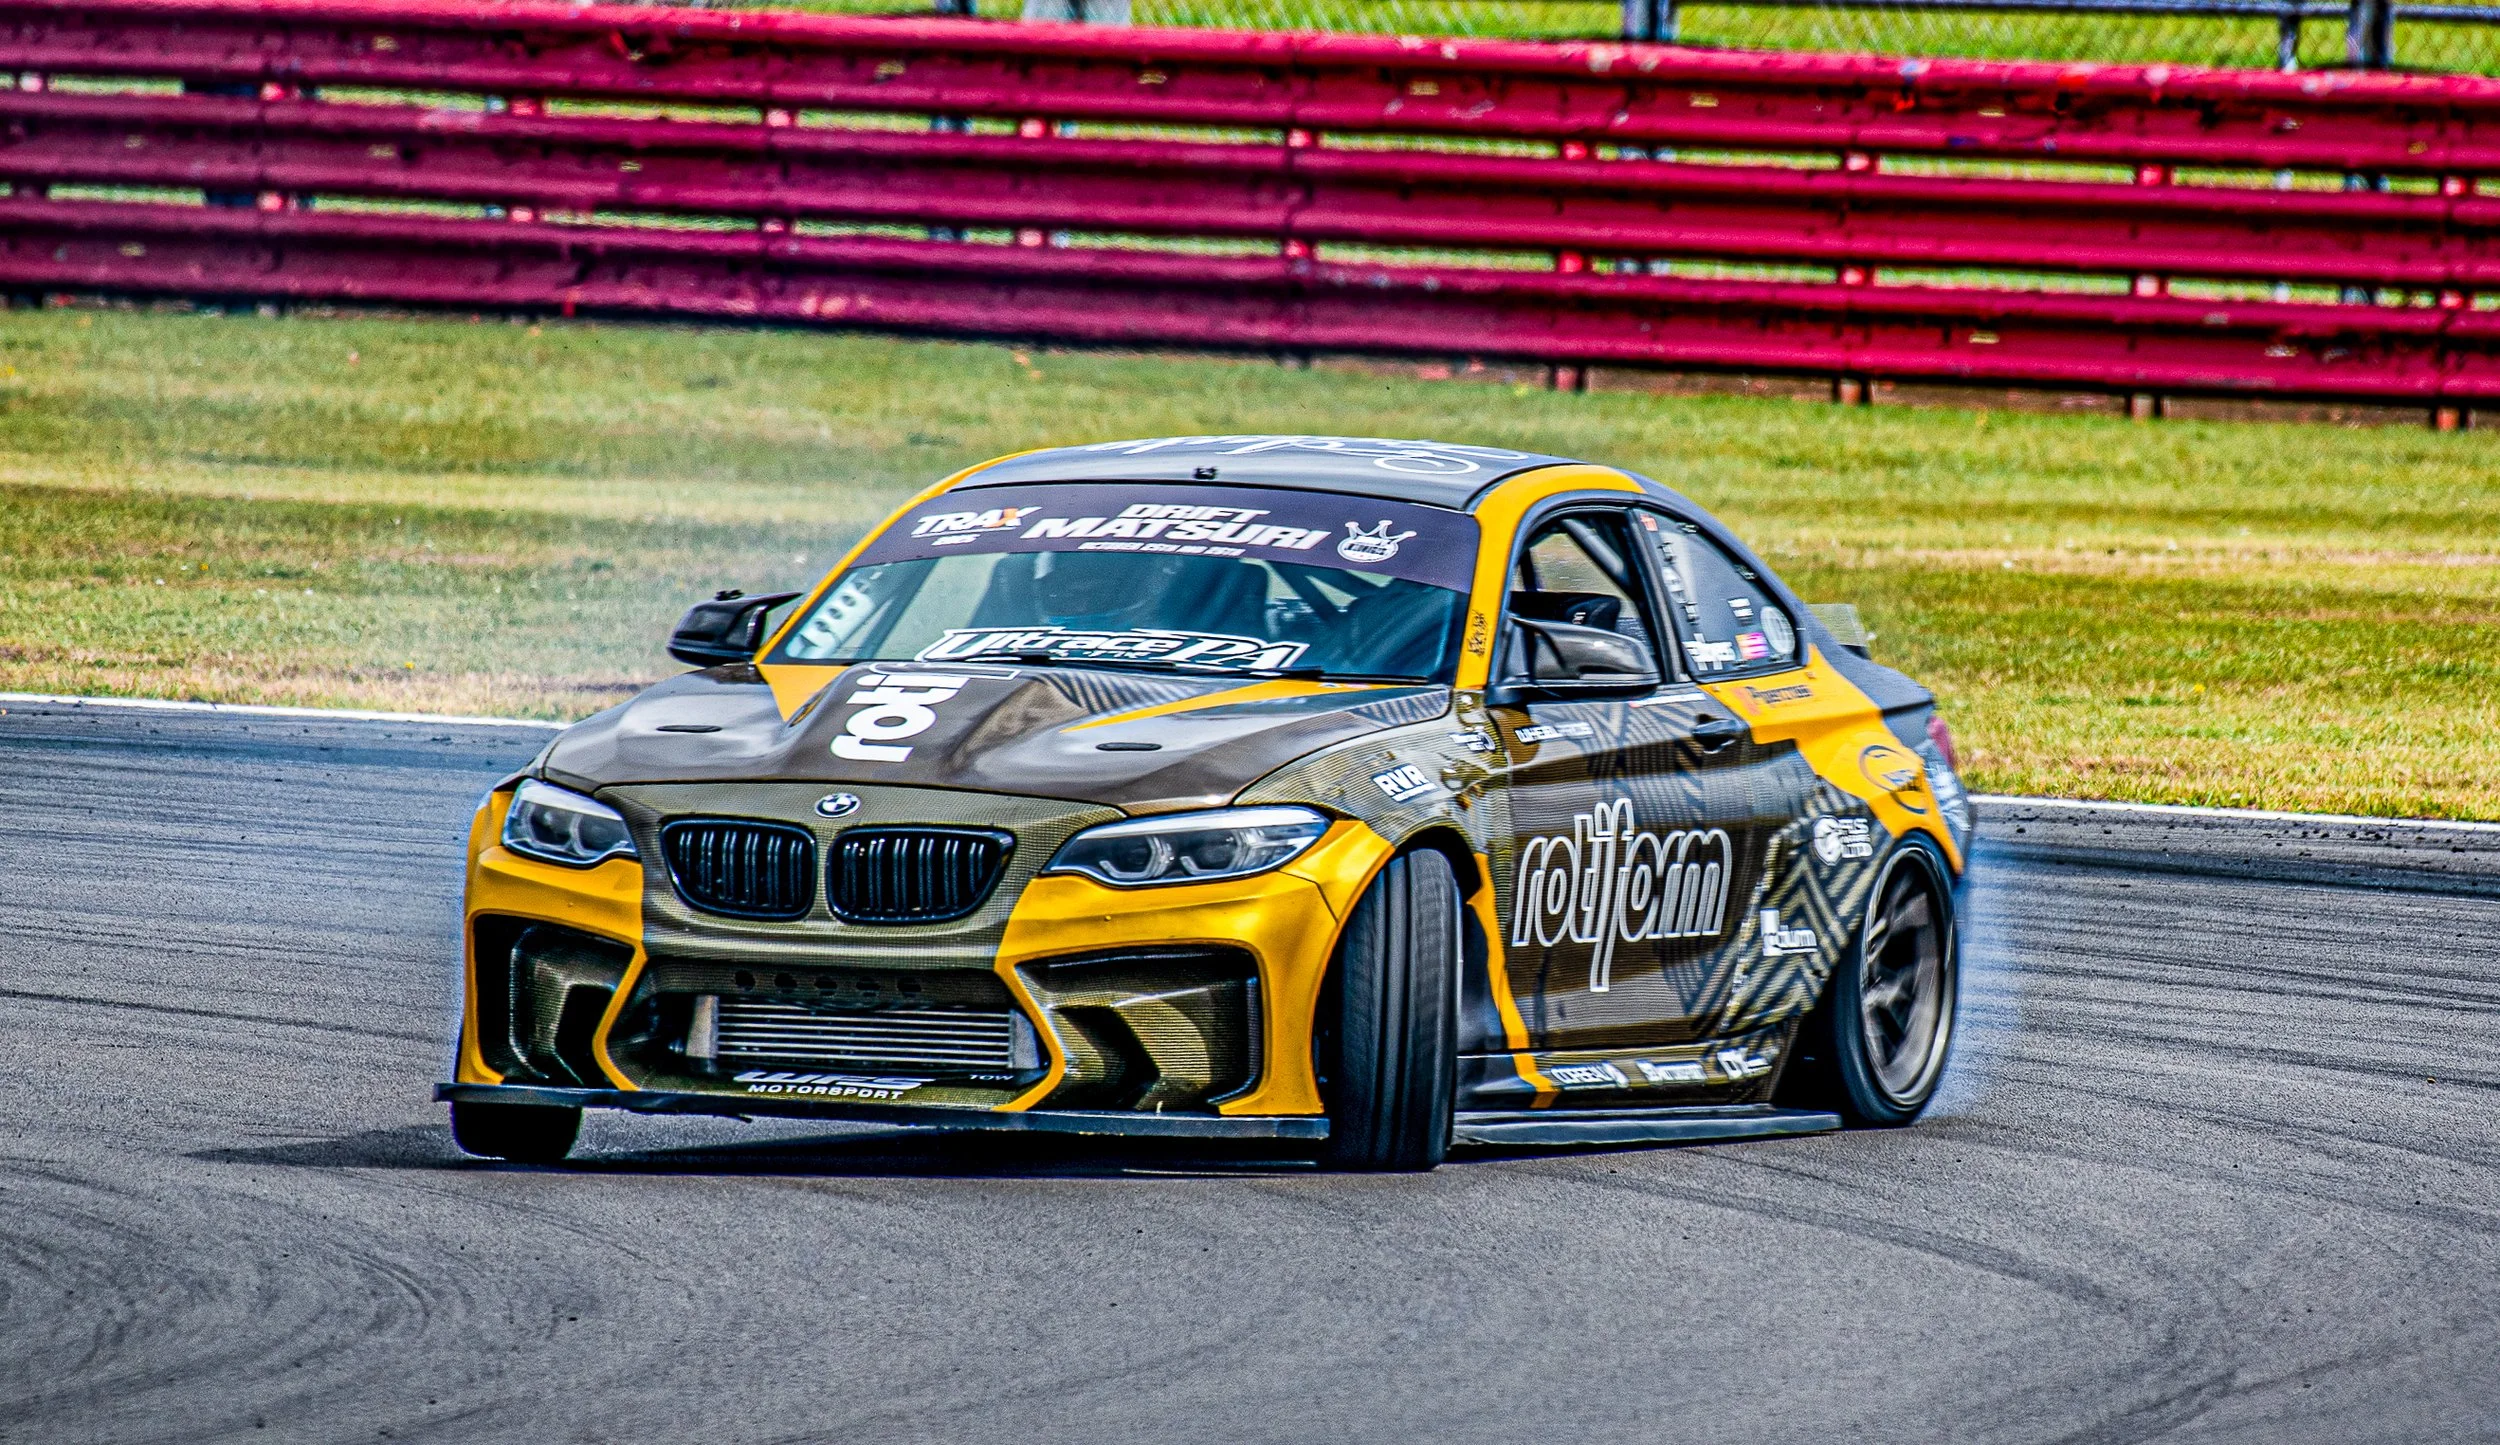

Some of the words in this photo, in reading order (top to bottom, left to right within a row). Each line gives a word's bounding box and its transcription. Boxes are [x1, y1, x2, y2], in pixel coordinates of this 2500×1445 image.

[911, 506, 1043, 536] TRAX
[1117, 503, 1271, 523] DRIFT
[1020, 517, 1332, 550] MATSURI
[1373, 764, 1429, 797] RVR
[1511, 797, 1733, 993] rotiform
[748, 1083, 905, 1101] MOTORSPORT
